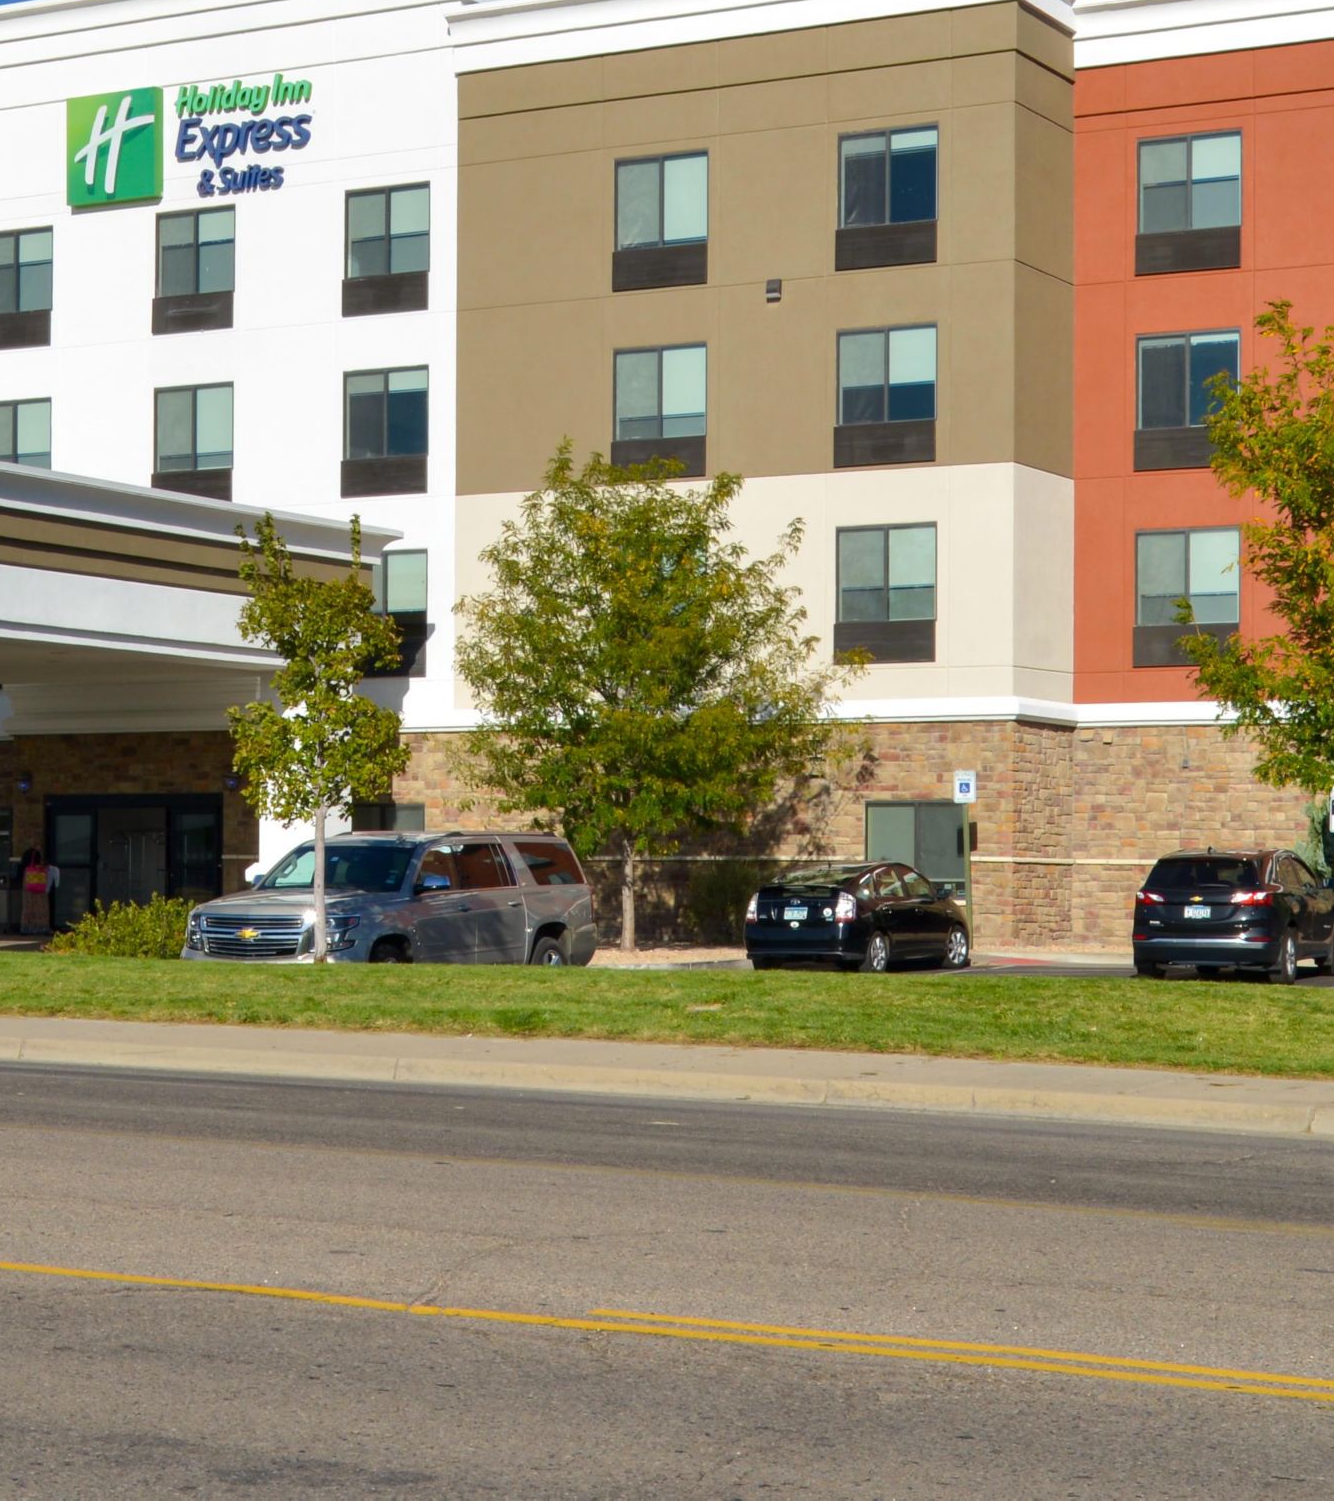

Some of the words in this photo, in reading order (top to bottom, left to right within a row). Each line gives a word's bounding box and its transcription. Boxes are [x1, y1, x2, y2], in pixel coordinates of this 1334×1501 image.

[175, 79, 269, 118] Holiday
[271, 73, 312, 105] Inn
[175, 114, 312, 169] Express
[197, 169, 215, 198] &
[217, 164, 284, 196] Suites
